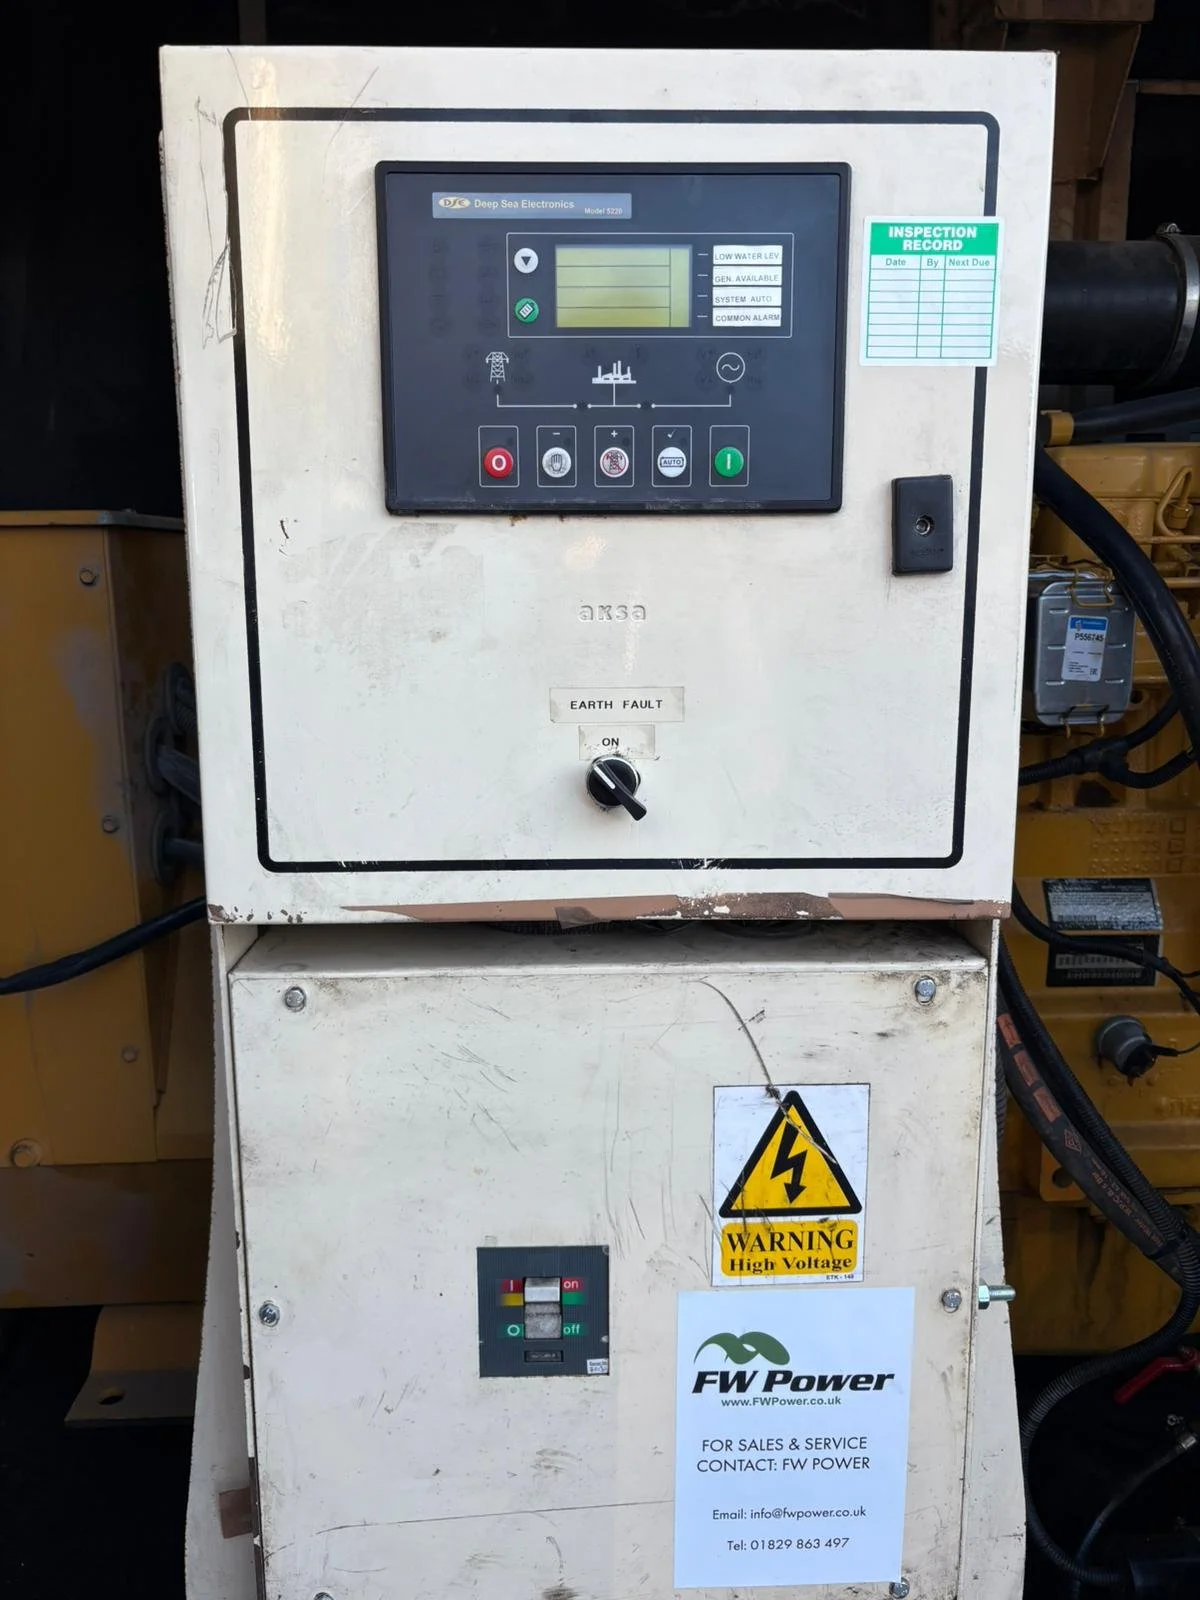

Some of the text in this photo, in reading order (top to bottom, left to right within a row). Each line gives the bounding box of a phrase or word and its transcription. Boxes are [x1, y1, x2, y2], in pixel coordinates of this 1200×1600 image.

[474, 200, 499, 210] Deep
[501, 200, 519, 209] Sea
[521, 200, 575, 209] Electronics
[584, 207, 605, 215] Model
[888, 226, 977, 238] INSPECTION
[902, 240, 963, 251] RECORD
[714, 253, 732, 261] LOW
[734, 252, 762, 260] WATER
[885, 258, 906, 266] Date
[948, 258, 990, 266] Next Due
[926, 258, 939, 268] By
[735, 274, 779, 282] AVAILABLE
[750, 295, 772, 303] AUTO
[715, 314, 751, 322] COMMON
[662, 458, 682, 466] AUTO
[579, 604, 646, 621] aksa
[570, 699, 663, 710] EARTH FAULT
[601, 737, 620, 747] ON
[726, 1229, 854, 1253] WARNING
[730, 1256, 852, 1274] High Voltage
[563, 1280, 579, 1289] on
[563, 1324, 580, 1335] off
[692, 1369, 895, 1394] FW Power
[721, 1395, 842, 1407] www.FWPower.co.uk
[702, 1436, 868, 1452] FOR SALES & SERVICE
[696, 1456, 871, 1473] CONTACT: FW POWER
[712, 1505, 866, 1521] Email: info@fwpower.co.uk
[727, 1537, 849, 1551] Tel: 01829 863 497
